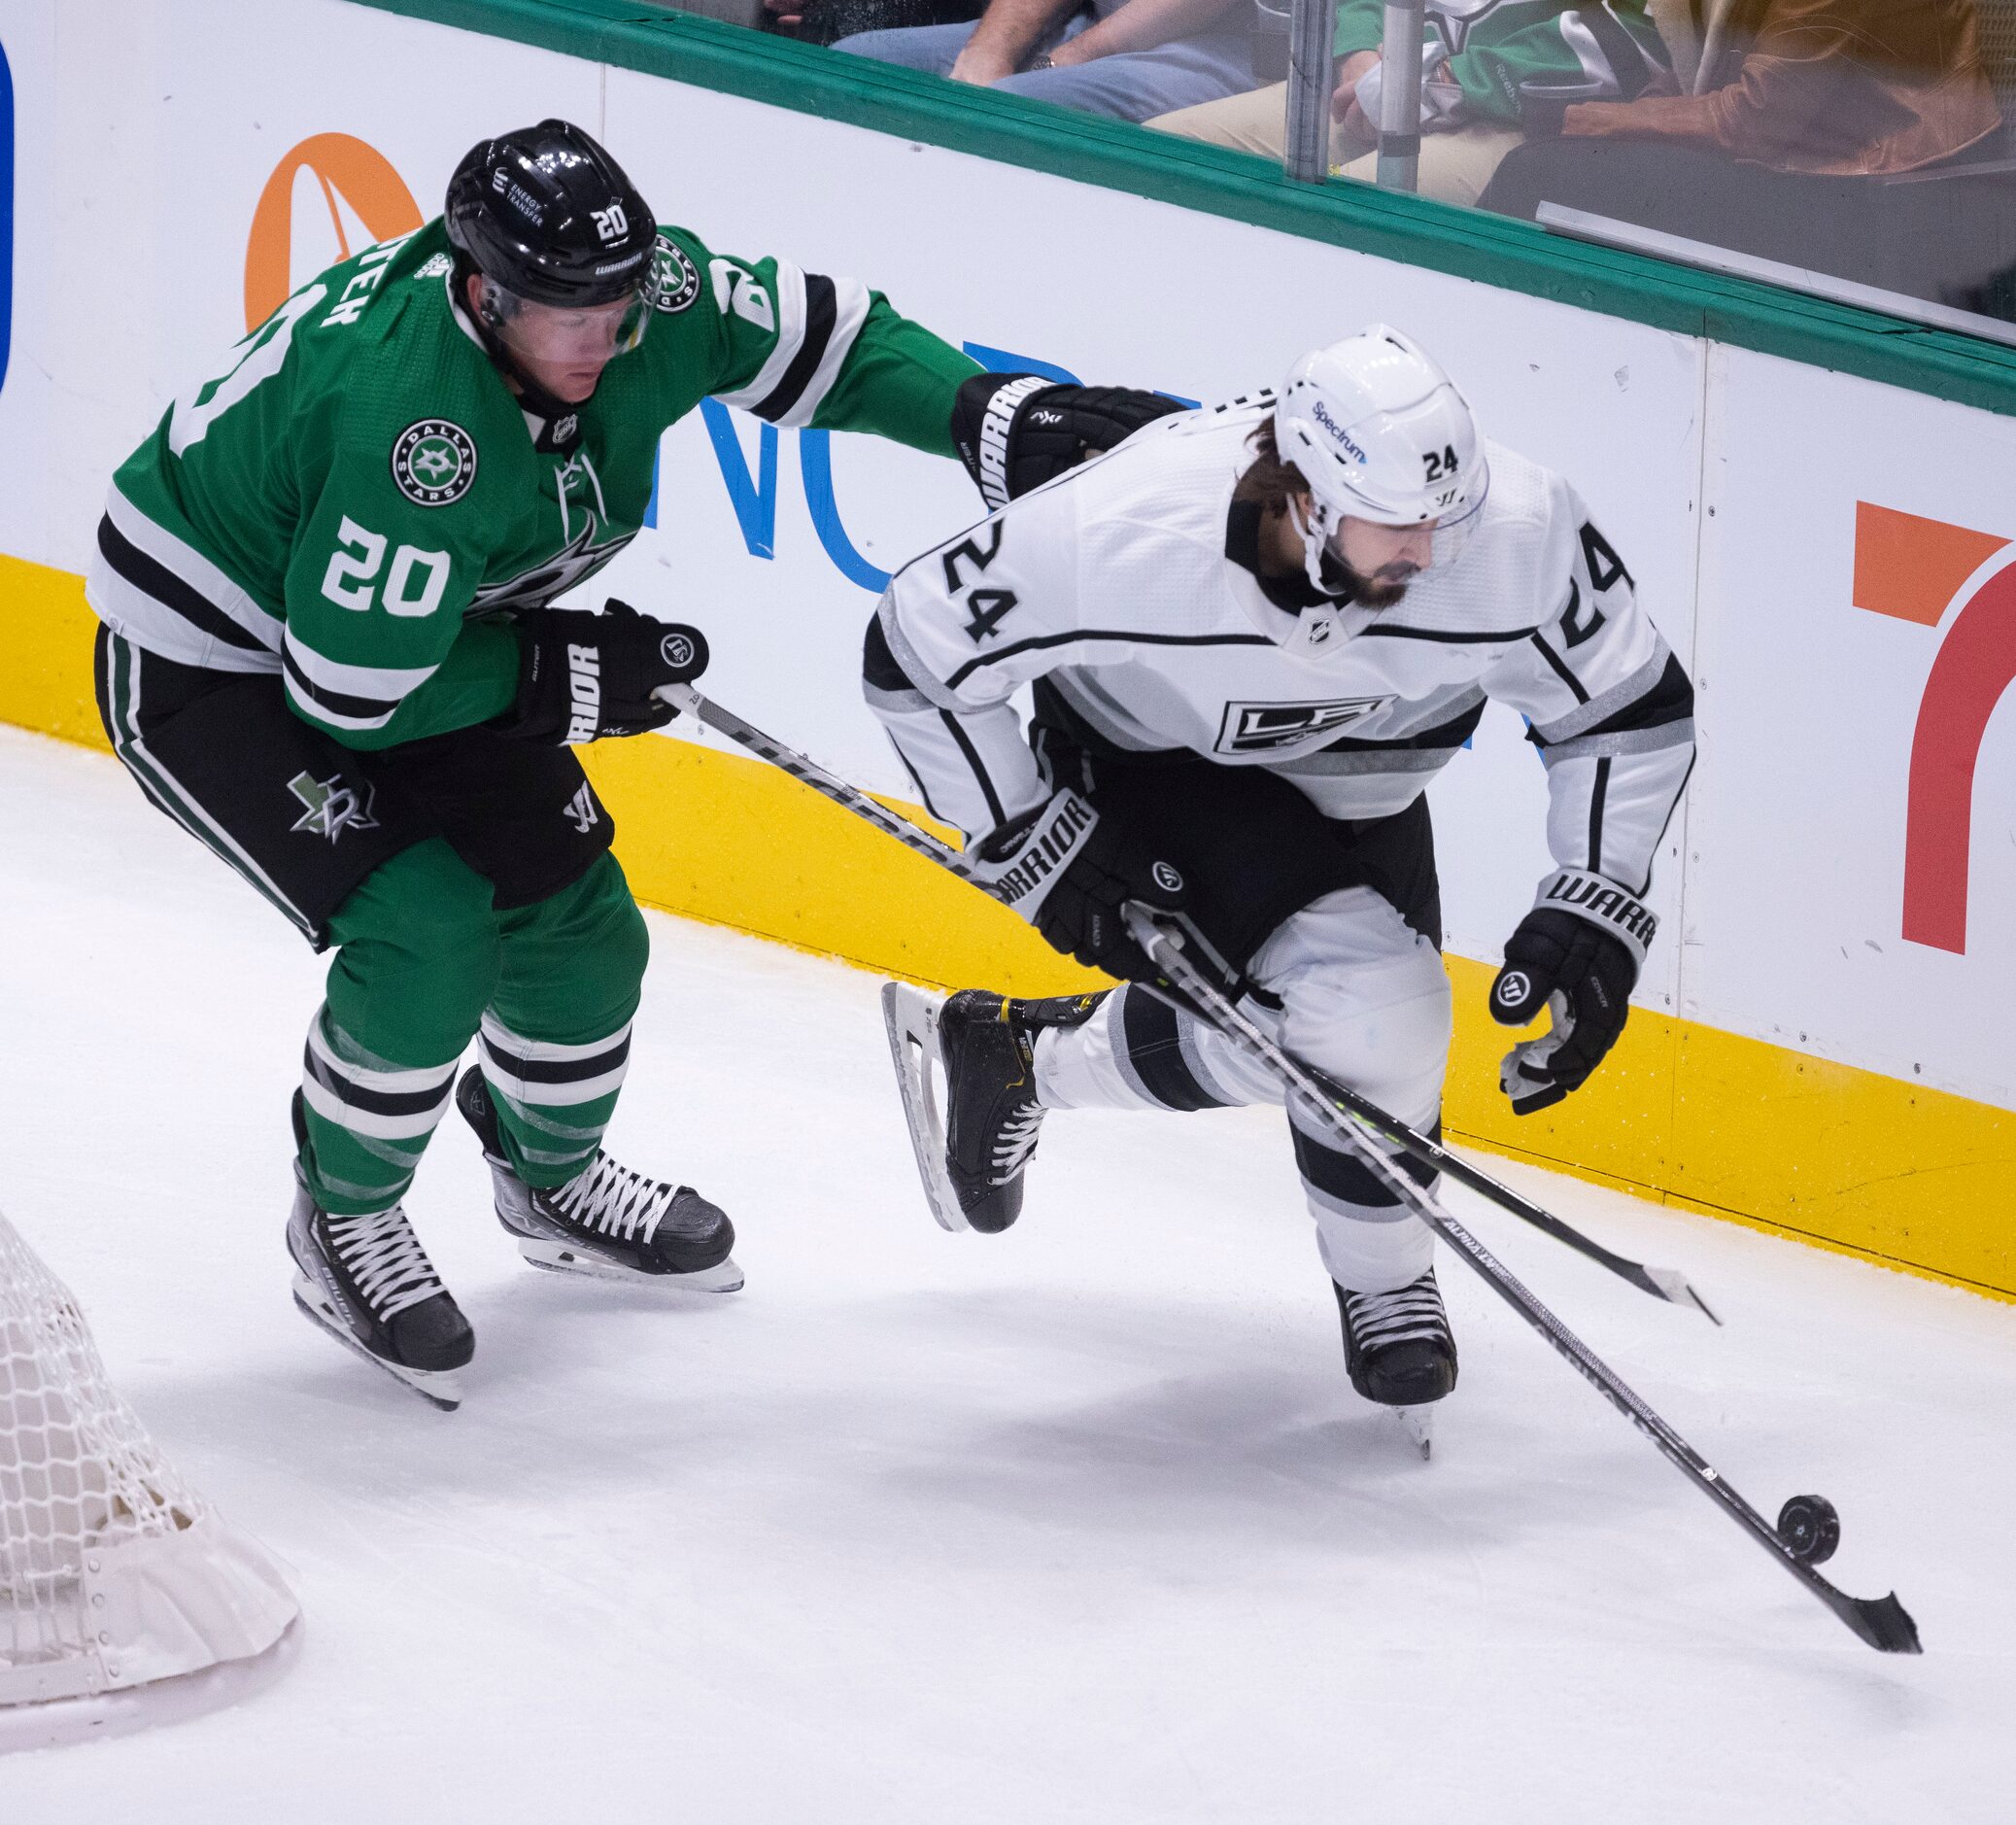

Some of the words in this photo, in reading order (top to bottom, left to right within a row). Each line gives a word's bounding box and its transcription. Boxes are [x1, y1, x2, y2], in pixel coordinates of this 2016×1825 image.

[506, 192, 544, 227] TRANSFER
[510, 183, 542, 211] ENERGY
[590, 204, 629, 241] 20
[595, 252, 642, 275] WARRIOR
[407, 425, 472, 473] DALLAS
[1312, 399, 1366, 465] Spectrum
[397, 461, 456, 500] STARS
[1422, 444, 1458, 483] 24
[320, 513, 452, 618] 20
[941, 515, 1019, 645] 24
[1557, 520, 1636, 650] 24
[557, 642, 600, 748] RIOR
[996, 796, 1093, 905] ARRIOR
